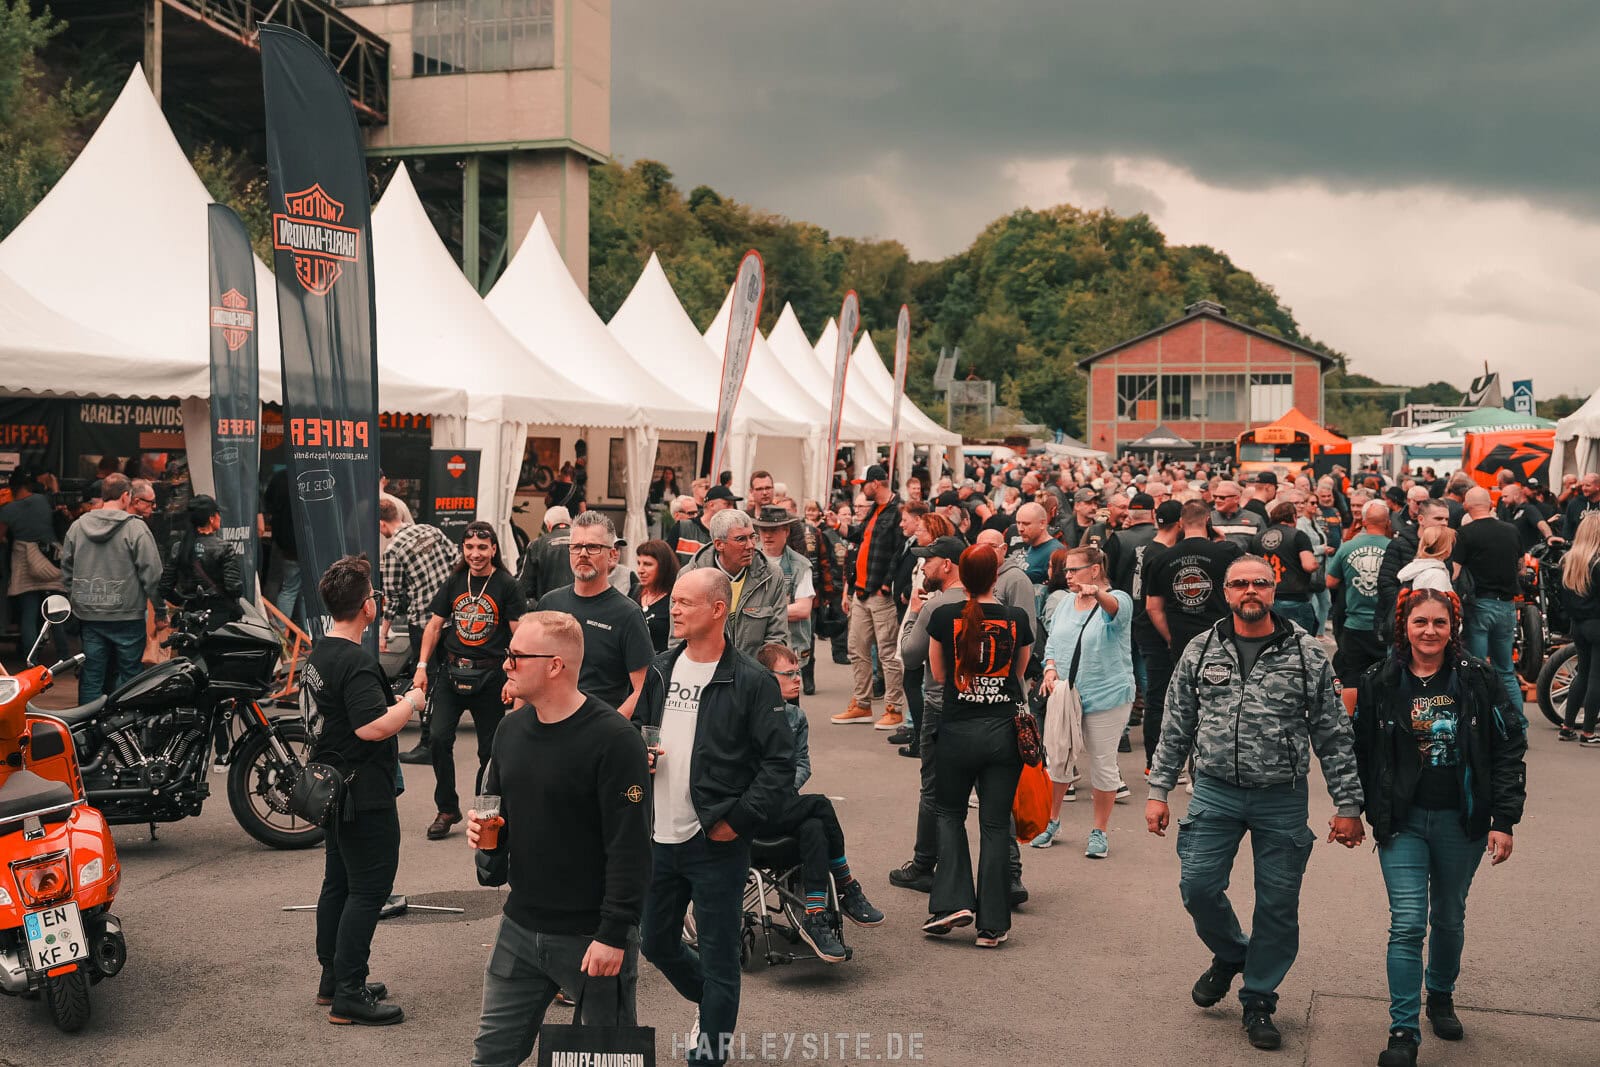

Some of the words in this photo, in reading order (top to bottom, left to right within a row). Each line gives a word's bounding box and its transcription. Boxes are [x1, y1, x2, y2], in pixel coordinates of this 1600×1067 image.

[435, 497, 475, 510] PFEIFFER
[981, 677, 1006, 687] GOT
[957, 692, 985, 703] FOR
[42, 907, 67, 927] EN
[38, 946, 61, 966] KF
[69, 942, 79, 957] 9
[552, 1051, 644, 1067] HARLEY-DAVIDSON
